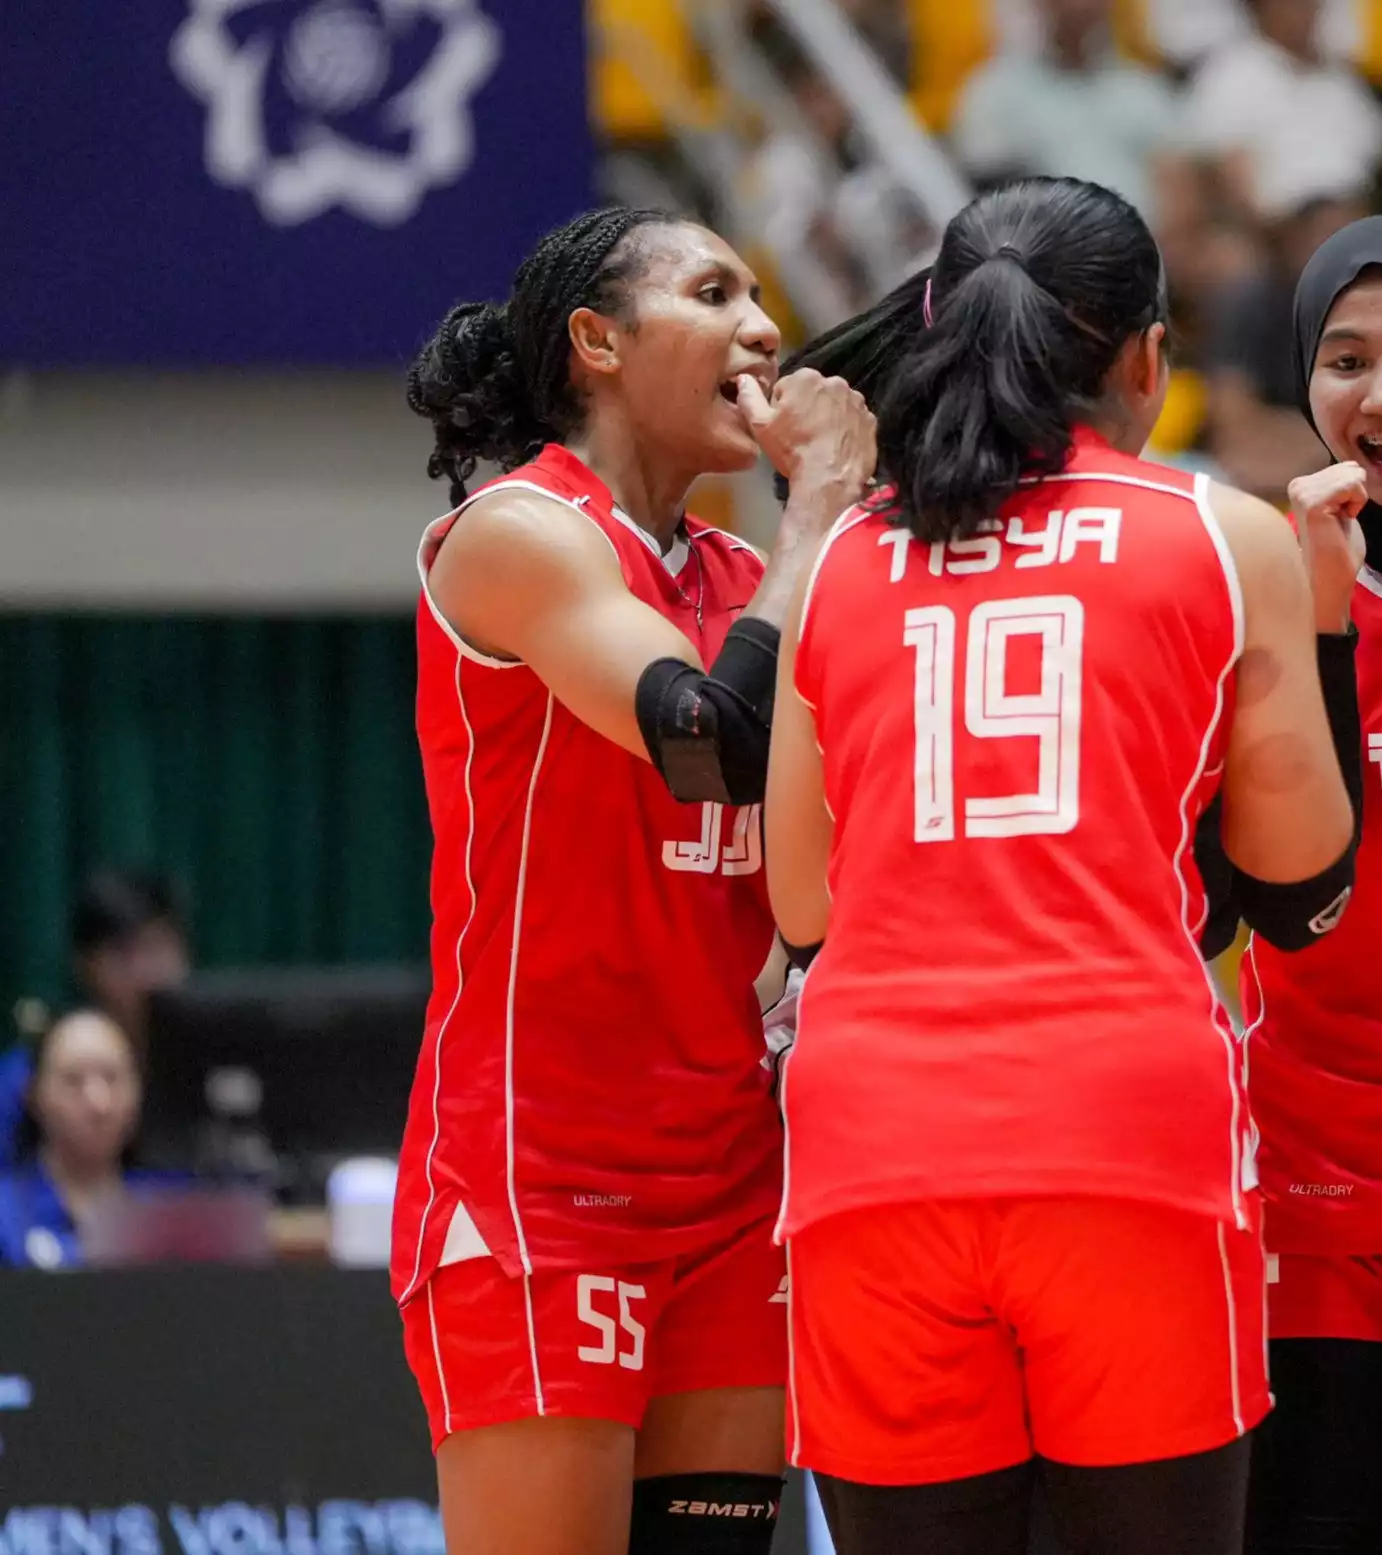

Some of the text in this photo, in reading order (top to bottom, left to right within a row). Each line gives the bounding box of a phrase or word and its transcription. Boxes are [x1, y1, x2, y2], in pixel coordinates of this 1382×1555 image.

[877, 506, 1123, 583] TISYA
[903, 594, 1084, 843] 19
[573, 1195, 632, 1207] ULTRADRY
[1289, 1184, 1354, 1197] ULTRADRY
[577, 1274, 647, 1371] 55
